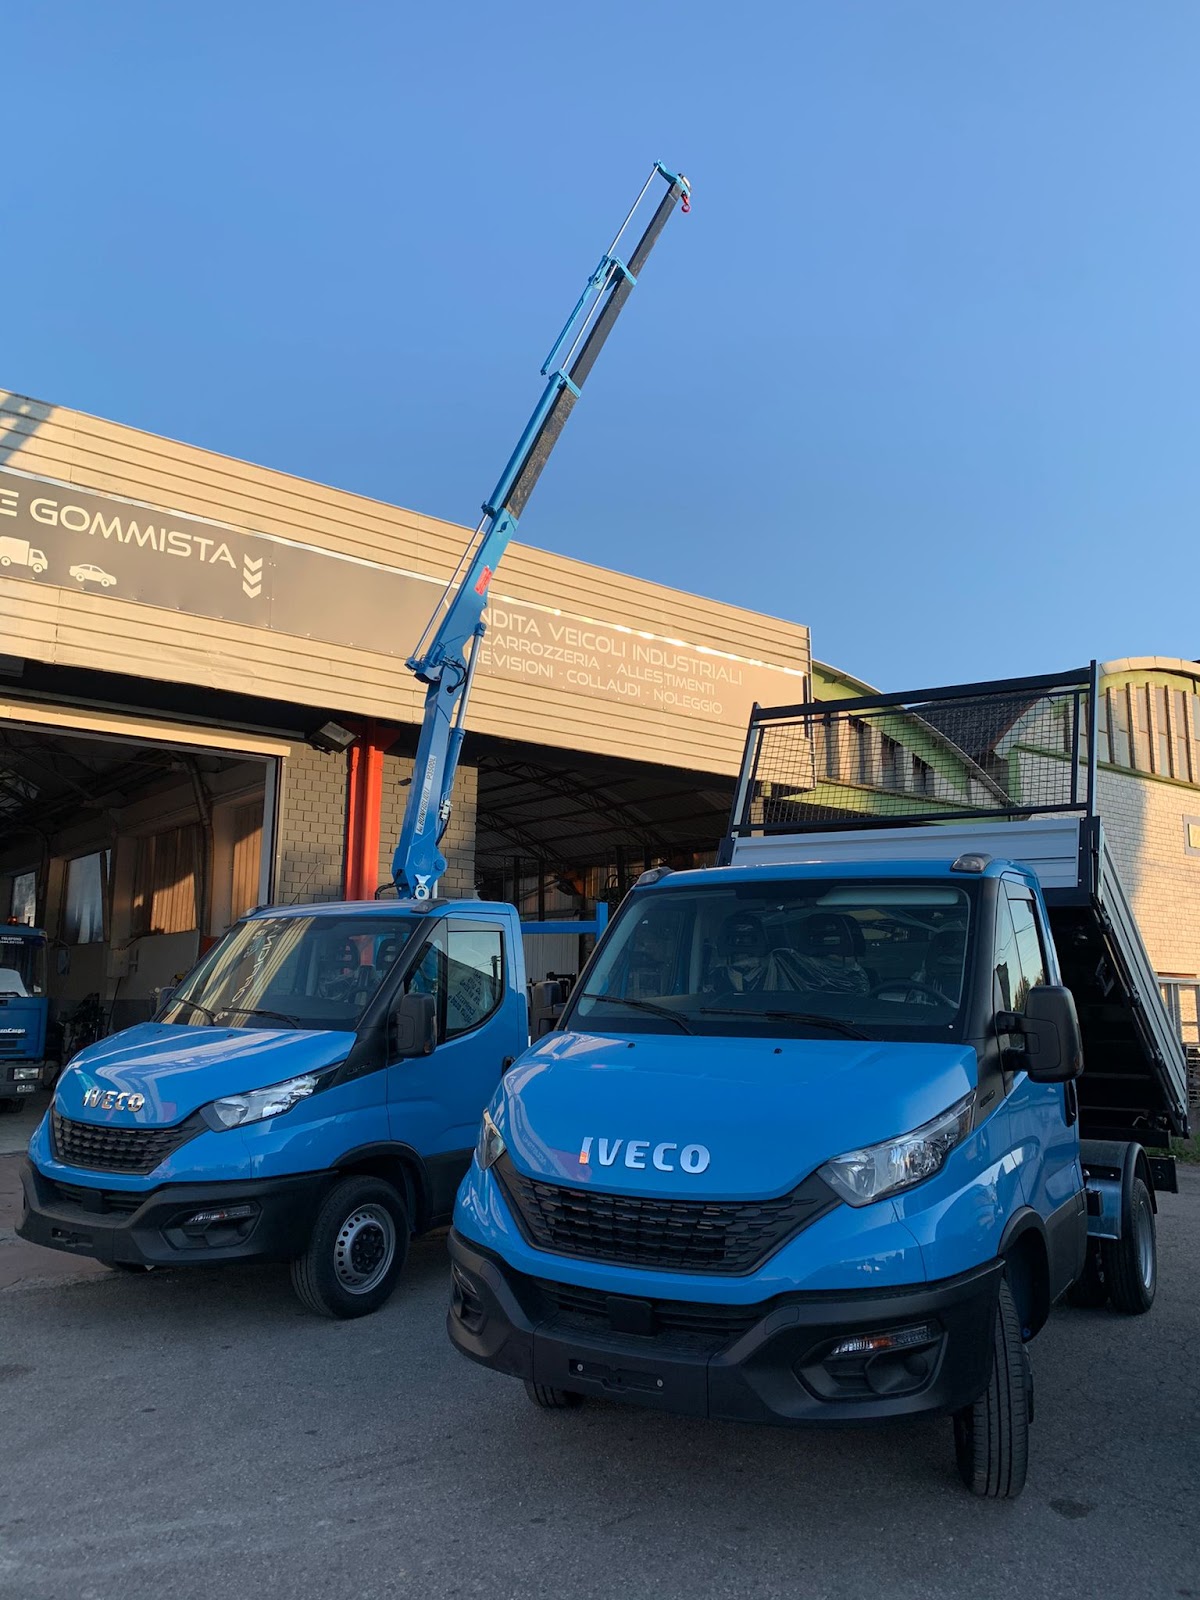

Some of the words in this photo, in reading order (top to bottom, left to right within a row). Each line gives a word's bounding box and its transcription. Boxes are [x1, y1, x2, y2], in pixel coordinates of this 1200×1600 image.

[0, 488, 19, 517] E
[30, 498, 237, 569] GOMMISTA
[482, 631, 600, 670] CARROZZERIA
[616, 663, 715, 695] ALLESTIMENTI
[548, 622, 626, 658] VEICOLI
[633, 644, 743, 685] INDUSTRIALI
[566, 670, 641, 697] COLLAUDI
[653, 688, 723, 715] NOLEGGIO
[83, 1088, 145, 1112] IVECO
[579, 1137, 711, 1174] IVECO
